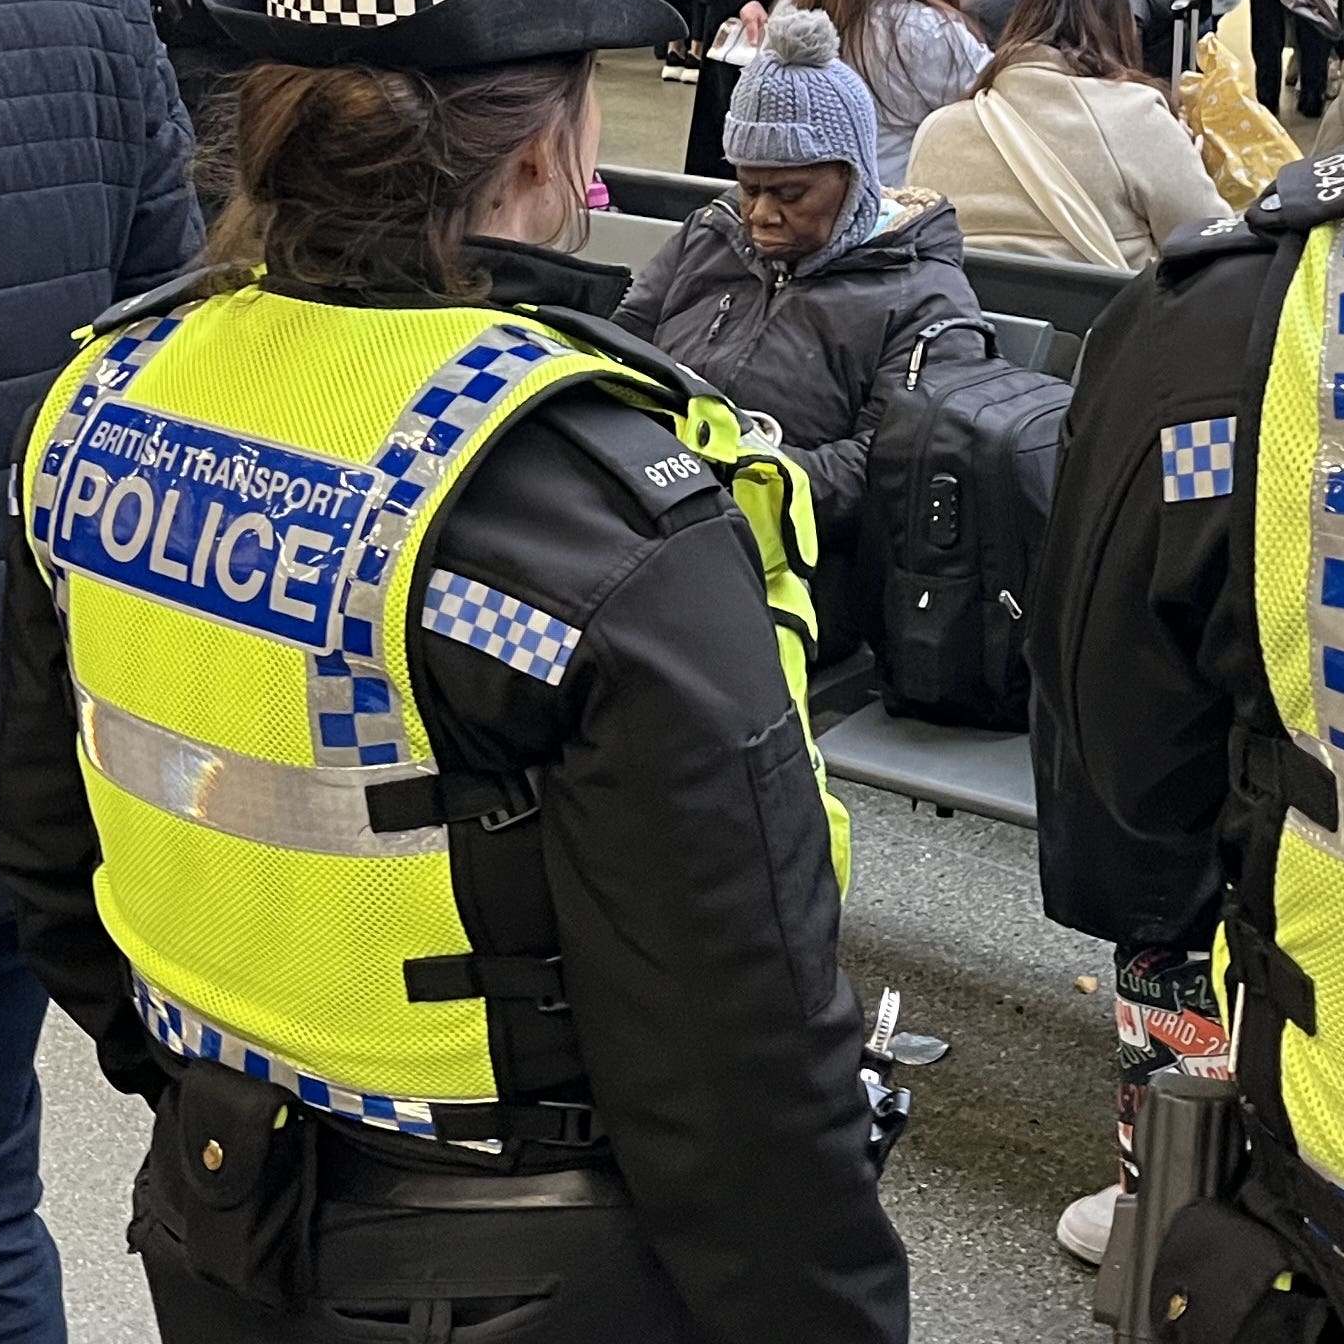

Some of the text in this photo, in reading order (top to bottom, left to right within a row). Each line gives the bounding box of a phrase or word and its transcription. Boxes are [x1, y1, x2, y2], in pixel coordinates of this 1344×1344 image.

[89, 420, 352, 519] BRITISH TRANSPORT
[60, 458, 335, 623] POLICE
